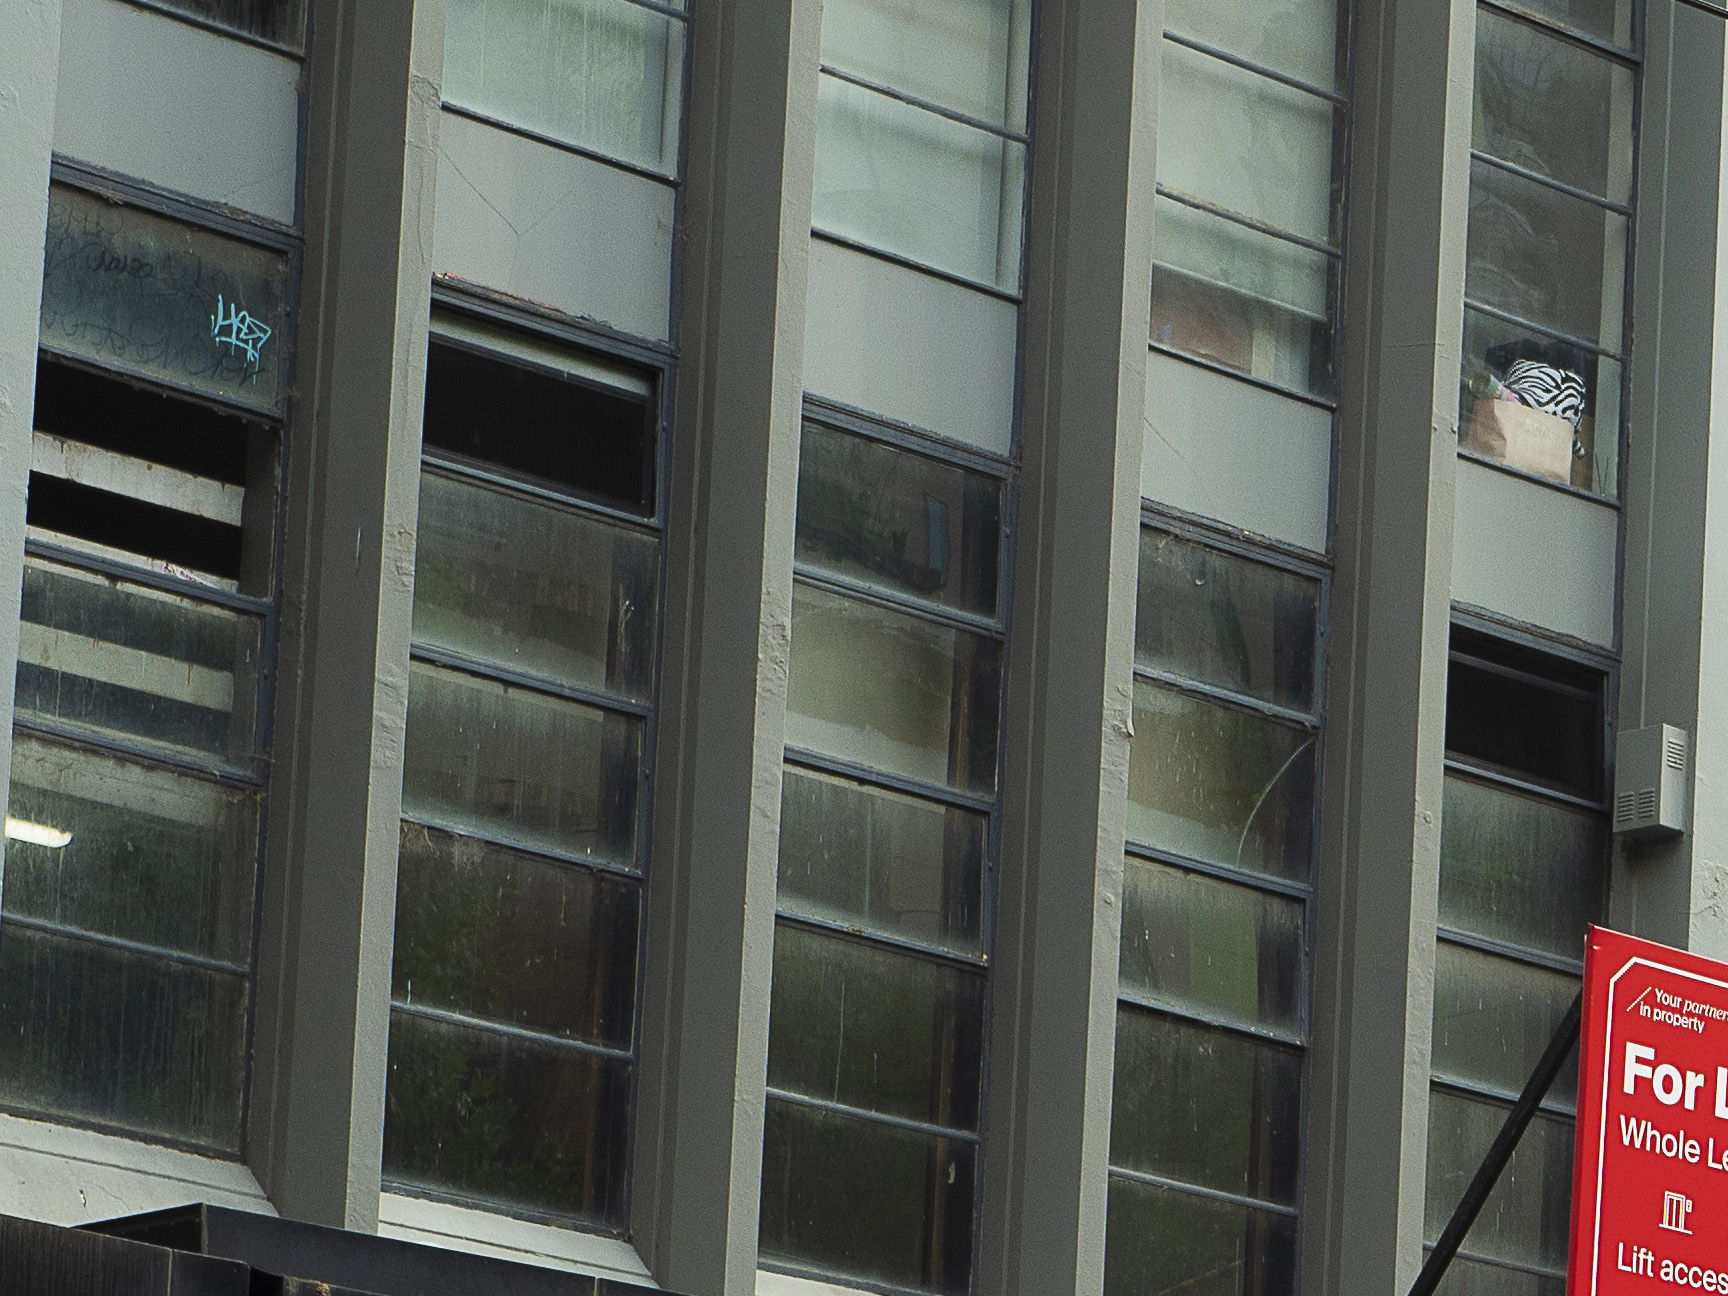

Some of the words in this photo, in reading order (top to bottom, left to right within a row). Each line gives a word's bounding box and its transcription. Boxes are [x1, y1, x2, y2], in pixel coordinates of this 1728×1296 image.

[1655, 987, 1682, 1008] Your
[1639, 1001, 1651, 1018] in
[1653, 1009, 1705, 1034] property
[1623, 1041, 1705, 1111] For
[1620, 1114, 1700, 1164] Whole
[1616, 1242, 1655, 1279] Lift
